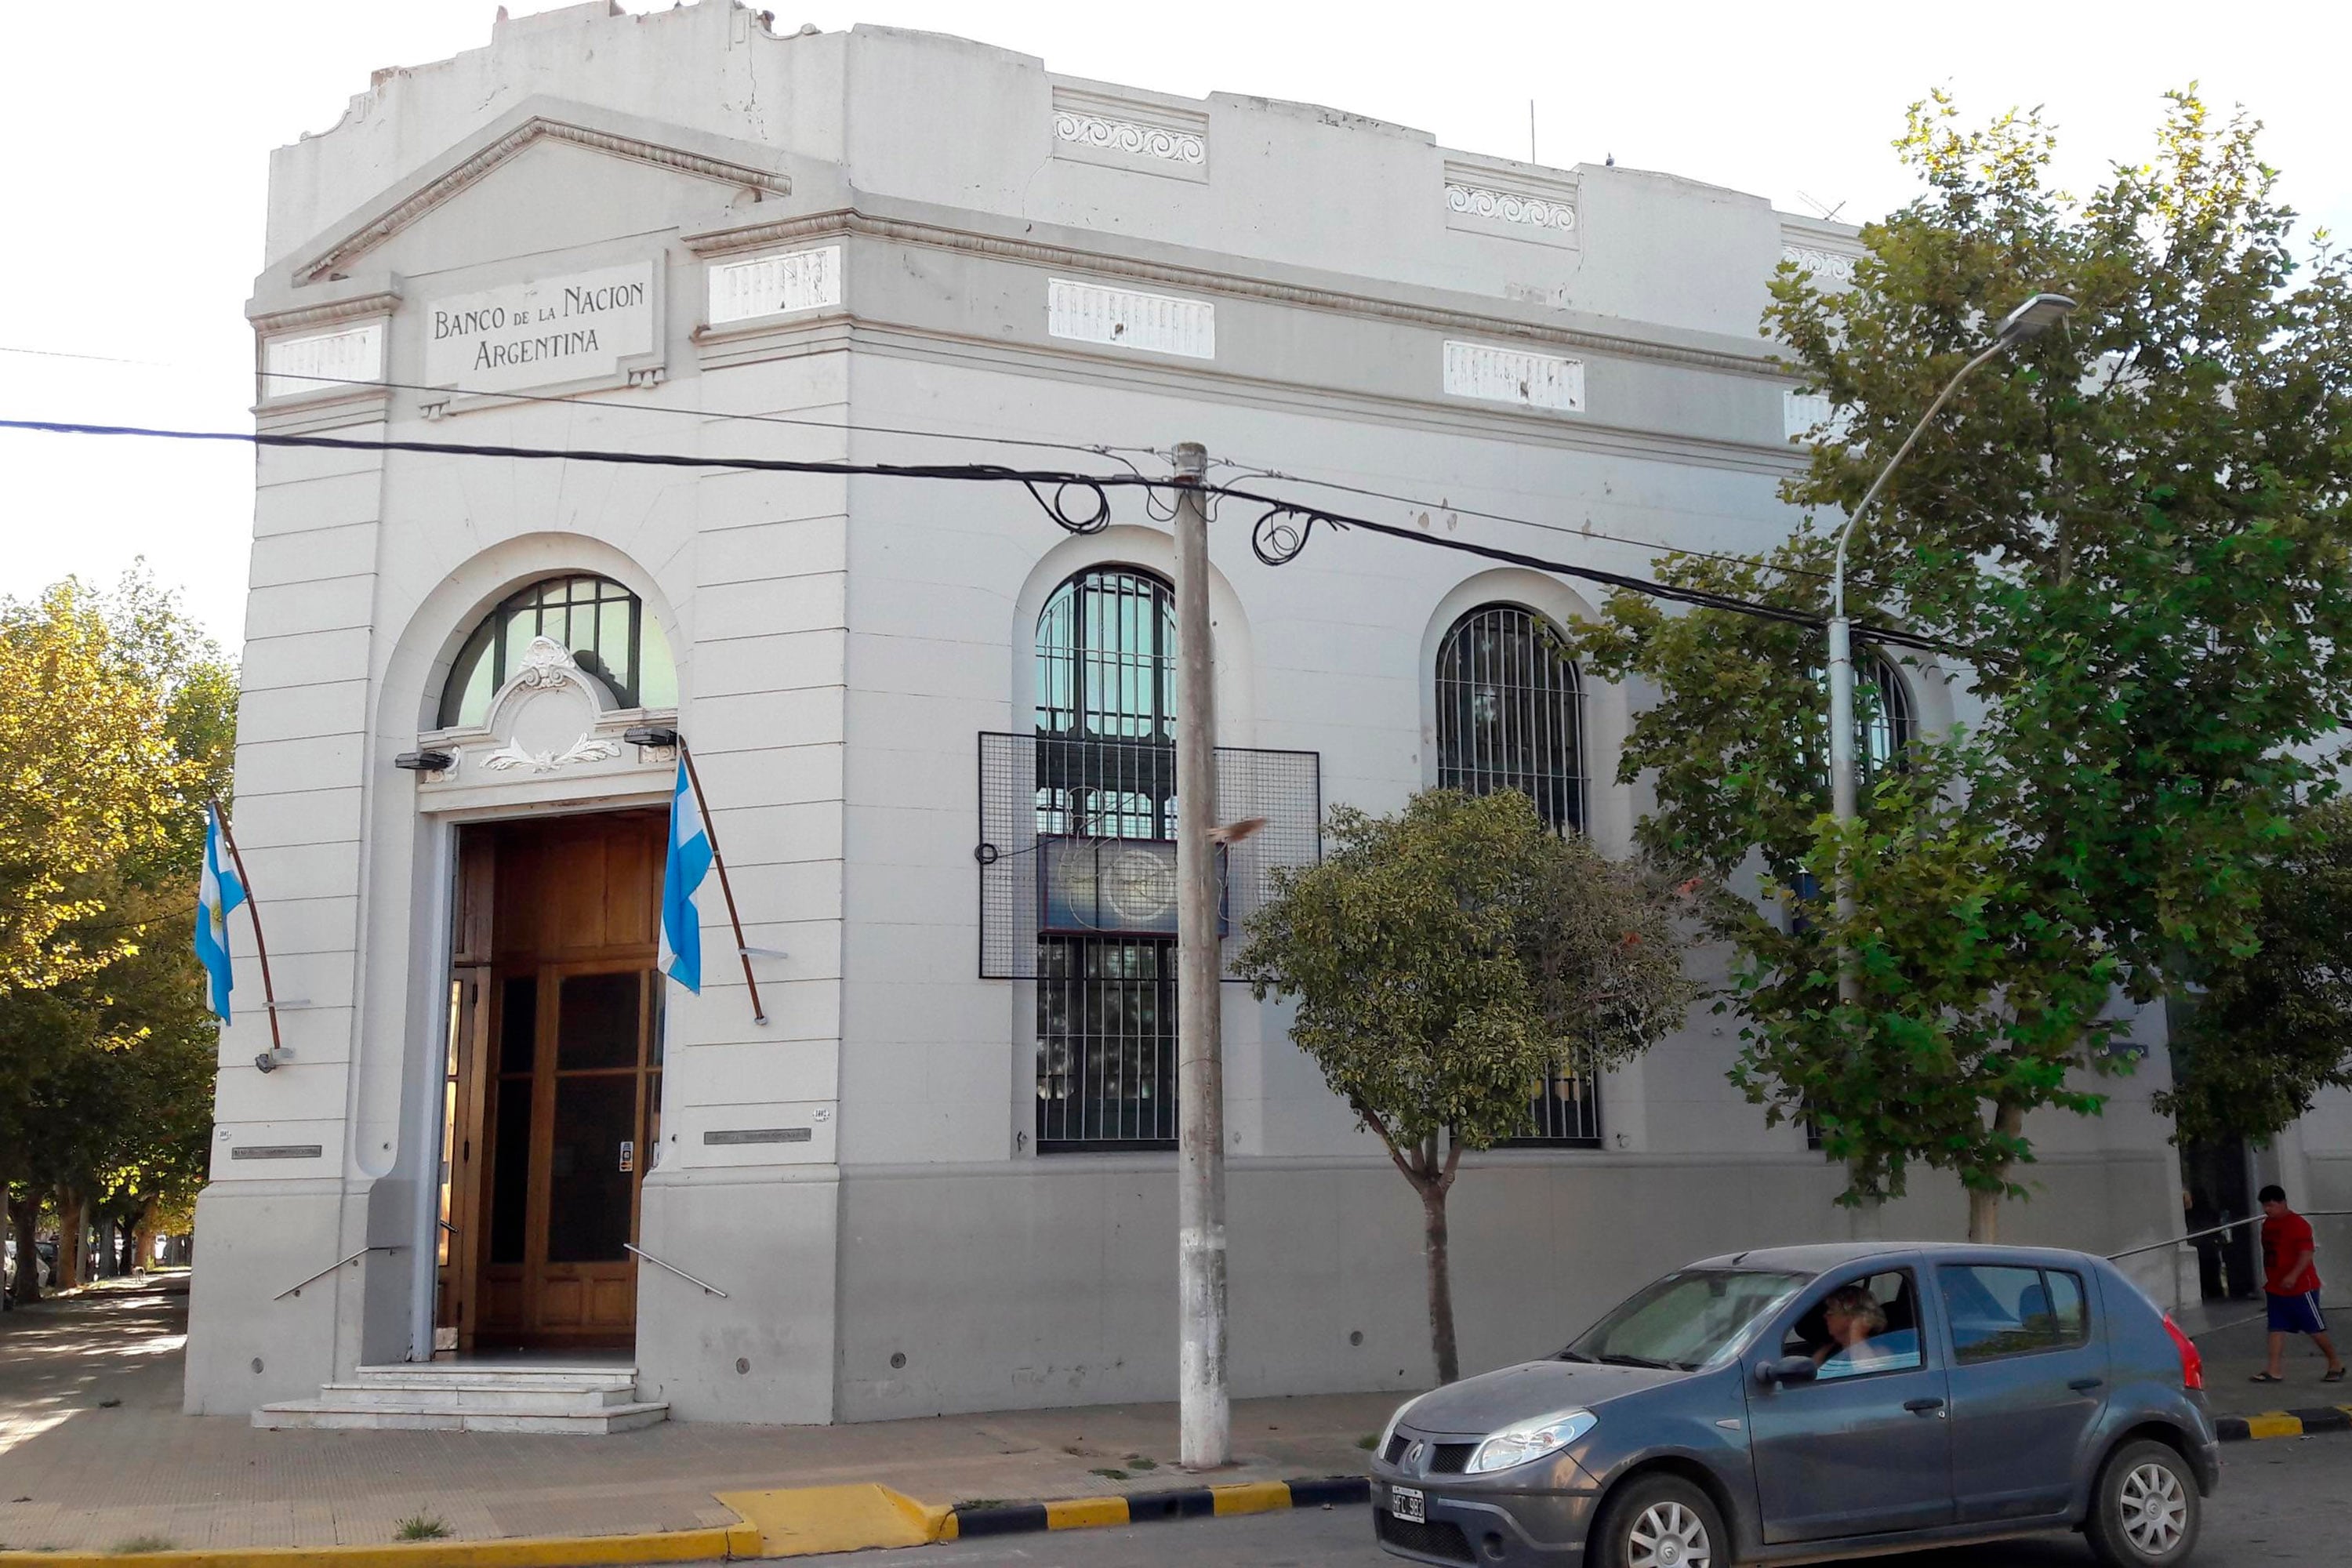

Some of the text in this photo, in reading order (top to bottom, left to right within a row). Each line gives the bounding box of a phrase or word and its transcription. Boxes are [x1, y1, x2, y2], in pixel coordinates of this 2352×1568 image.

[434, 282, 644, 340] BANCO DE LA NACION
[474, 329, 600, 371] ARGENTINA
